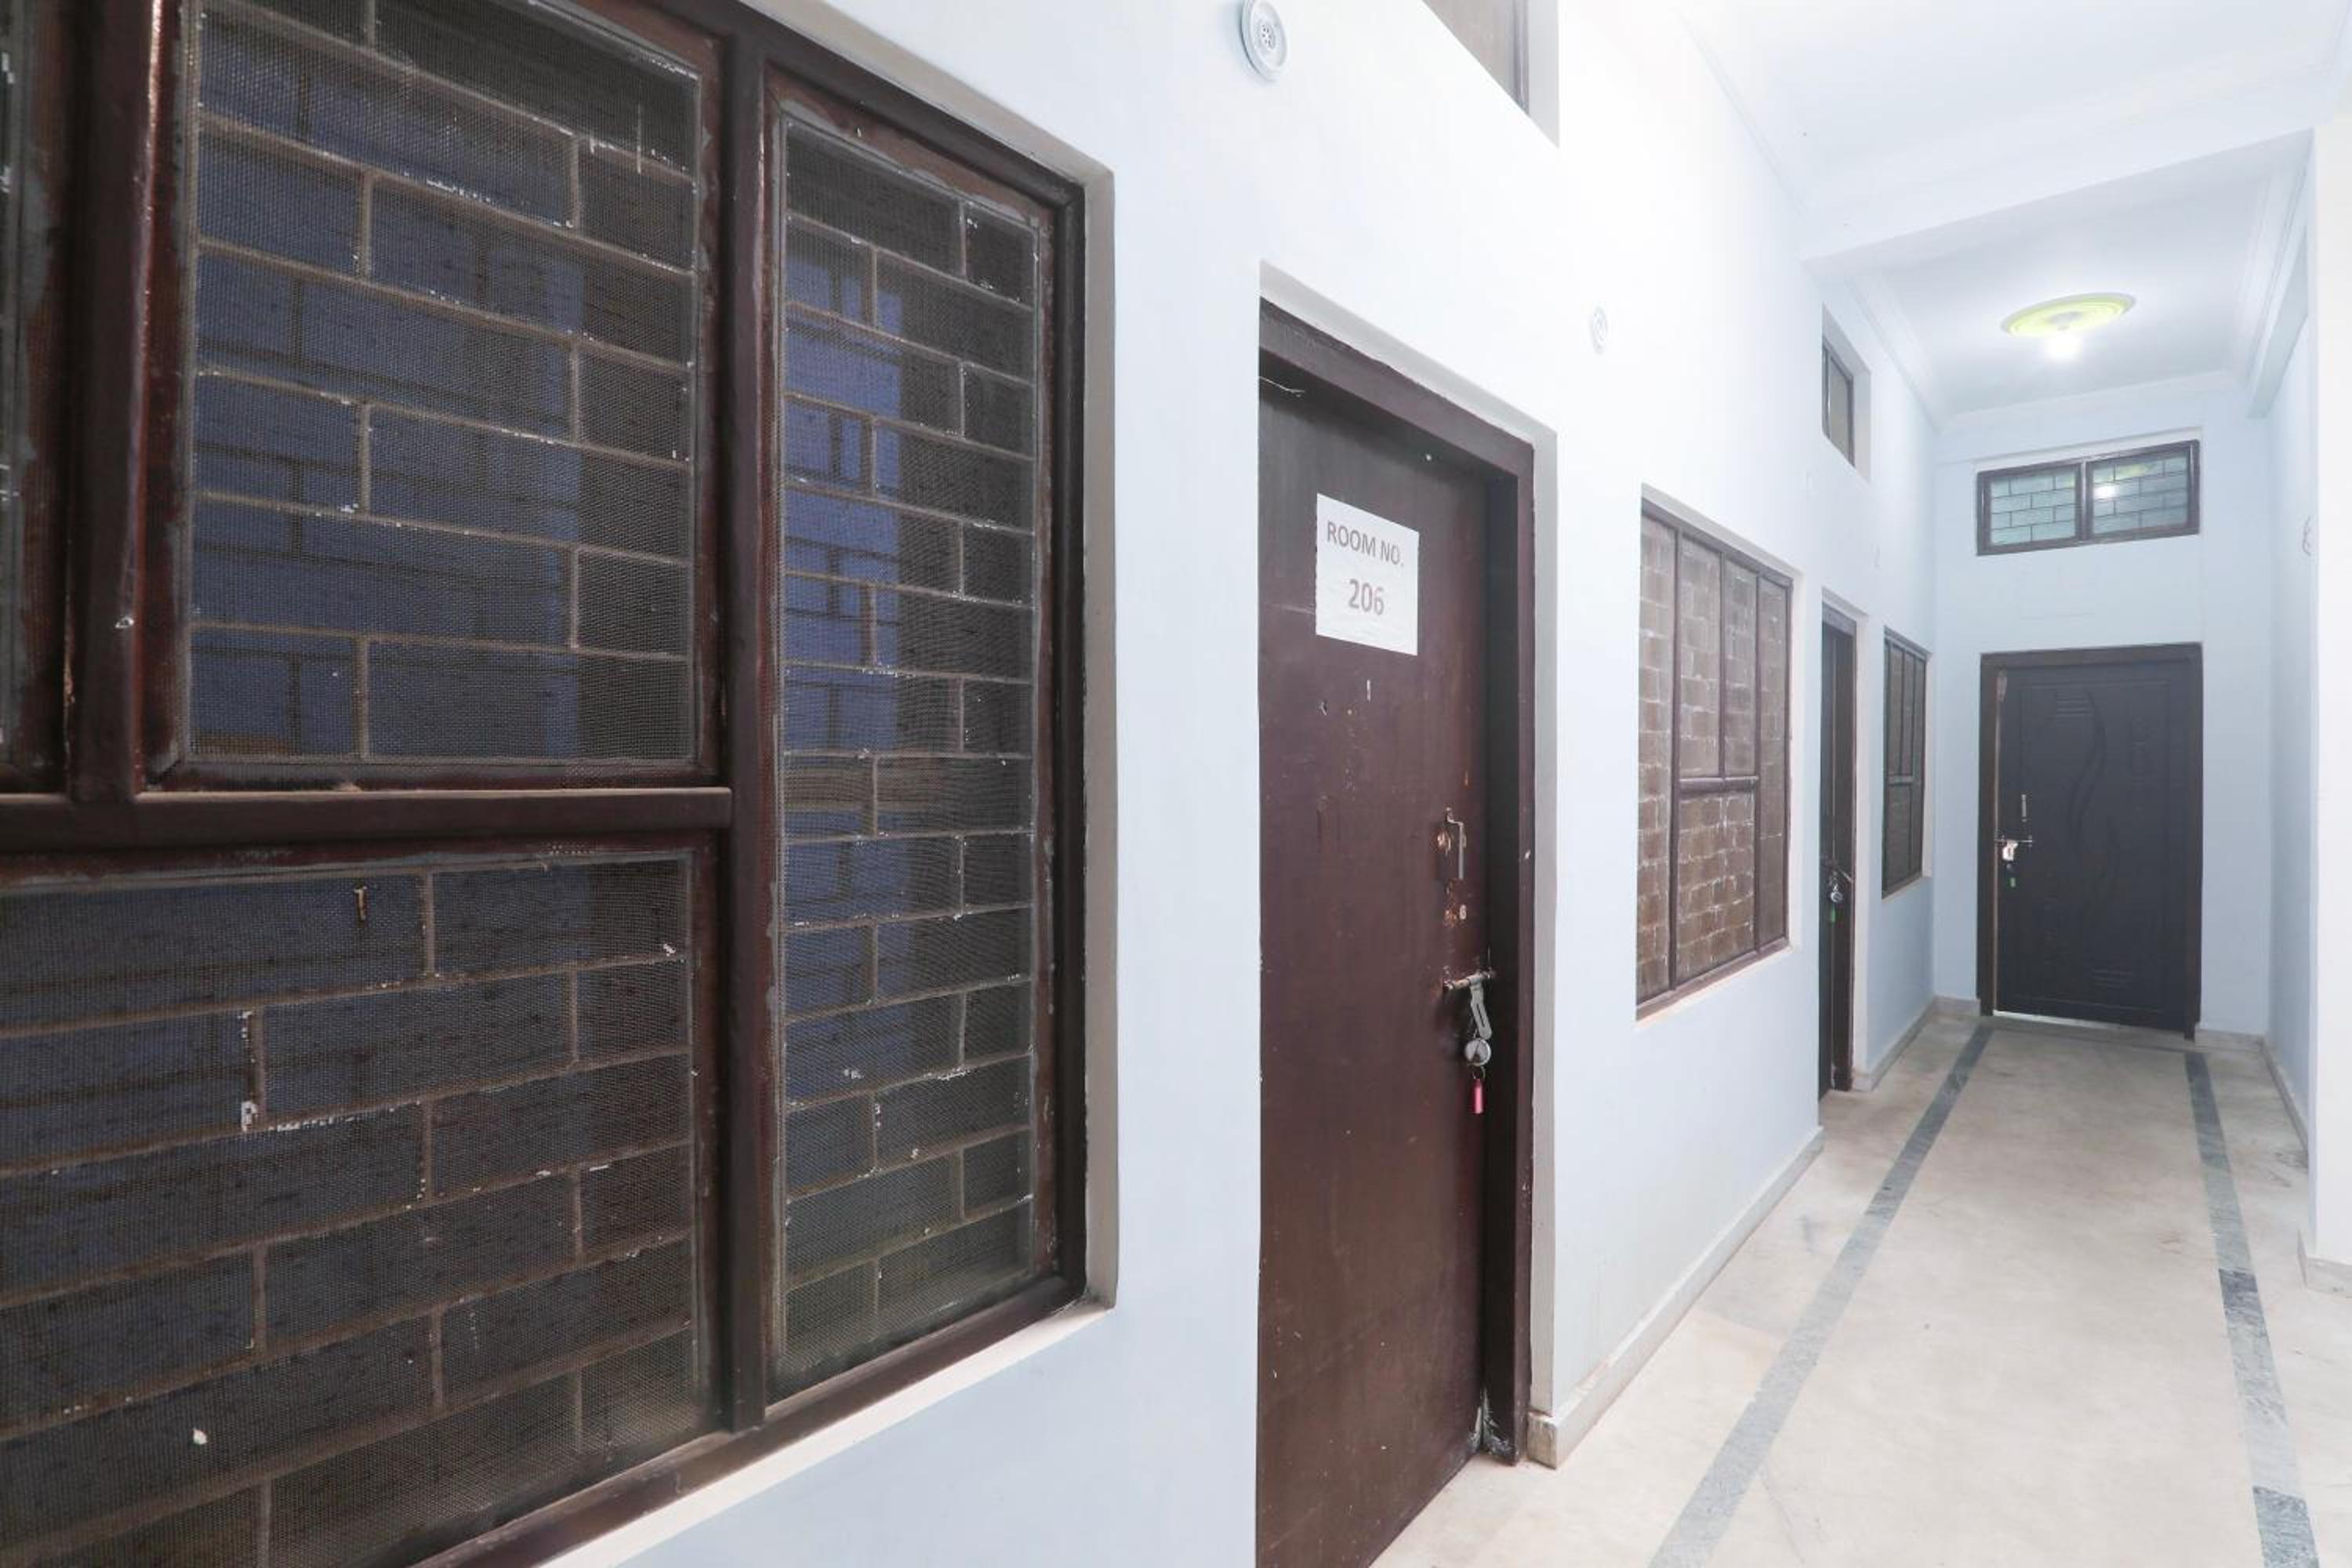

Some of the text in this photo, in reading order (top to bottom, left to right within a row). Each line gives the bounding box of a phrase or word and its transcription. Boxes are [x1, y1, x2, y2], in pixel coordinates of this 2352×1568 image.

[1327, 521, 1404, 567] ROOM NO.
[1348, 579, 1385, 615] 206
